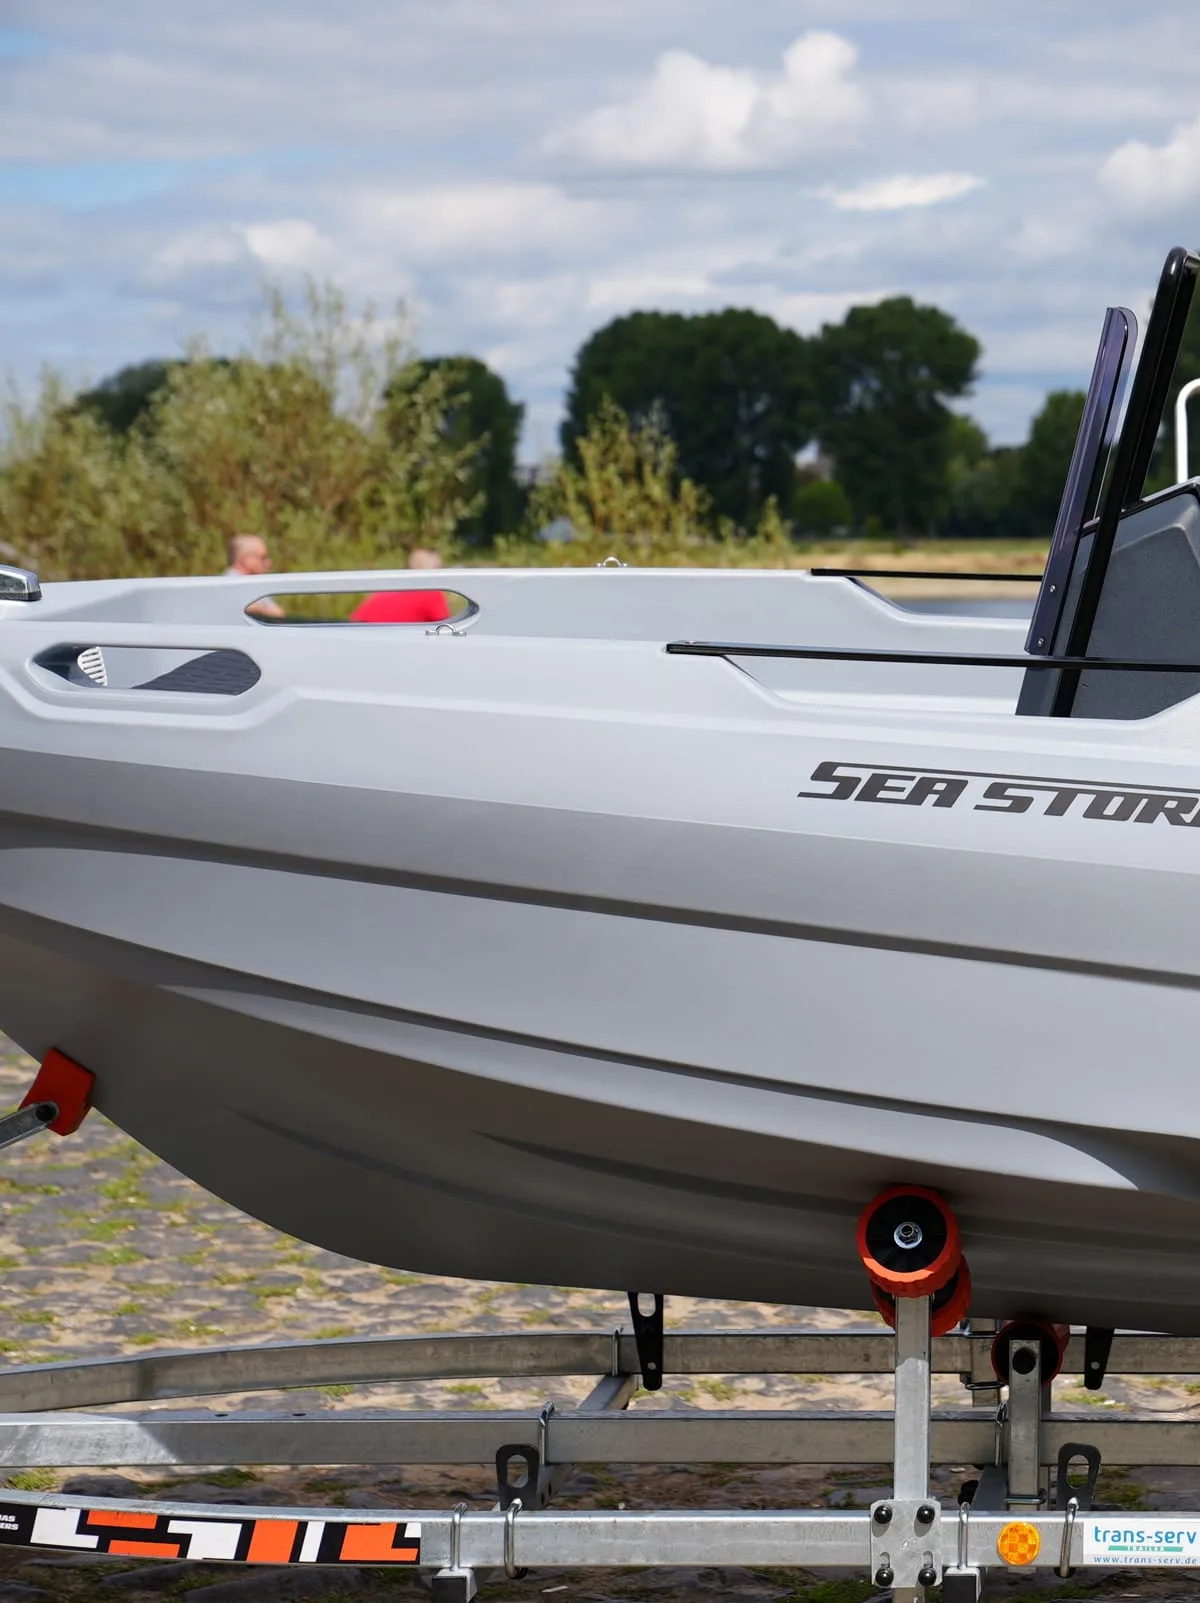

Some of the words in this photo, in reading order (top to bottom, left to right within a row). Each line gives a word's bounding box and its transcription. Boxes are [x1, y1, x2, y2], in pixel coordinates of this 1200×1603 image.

[797, 761, 969, 808] SEA
[1094, 1525, 1198, 1545] trans-serv
[1093, 1555, 1198, 1566] www.trans-serv.de
